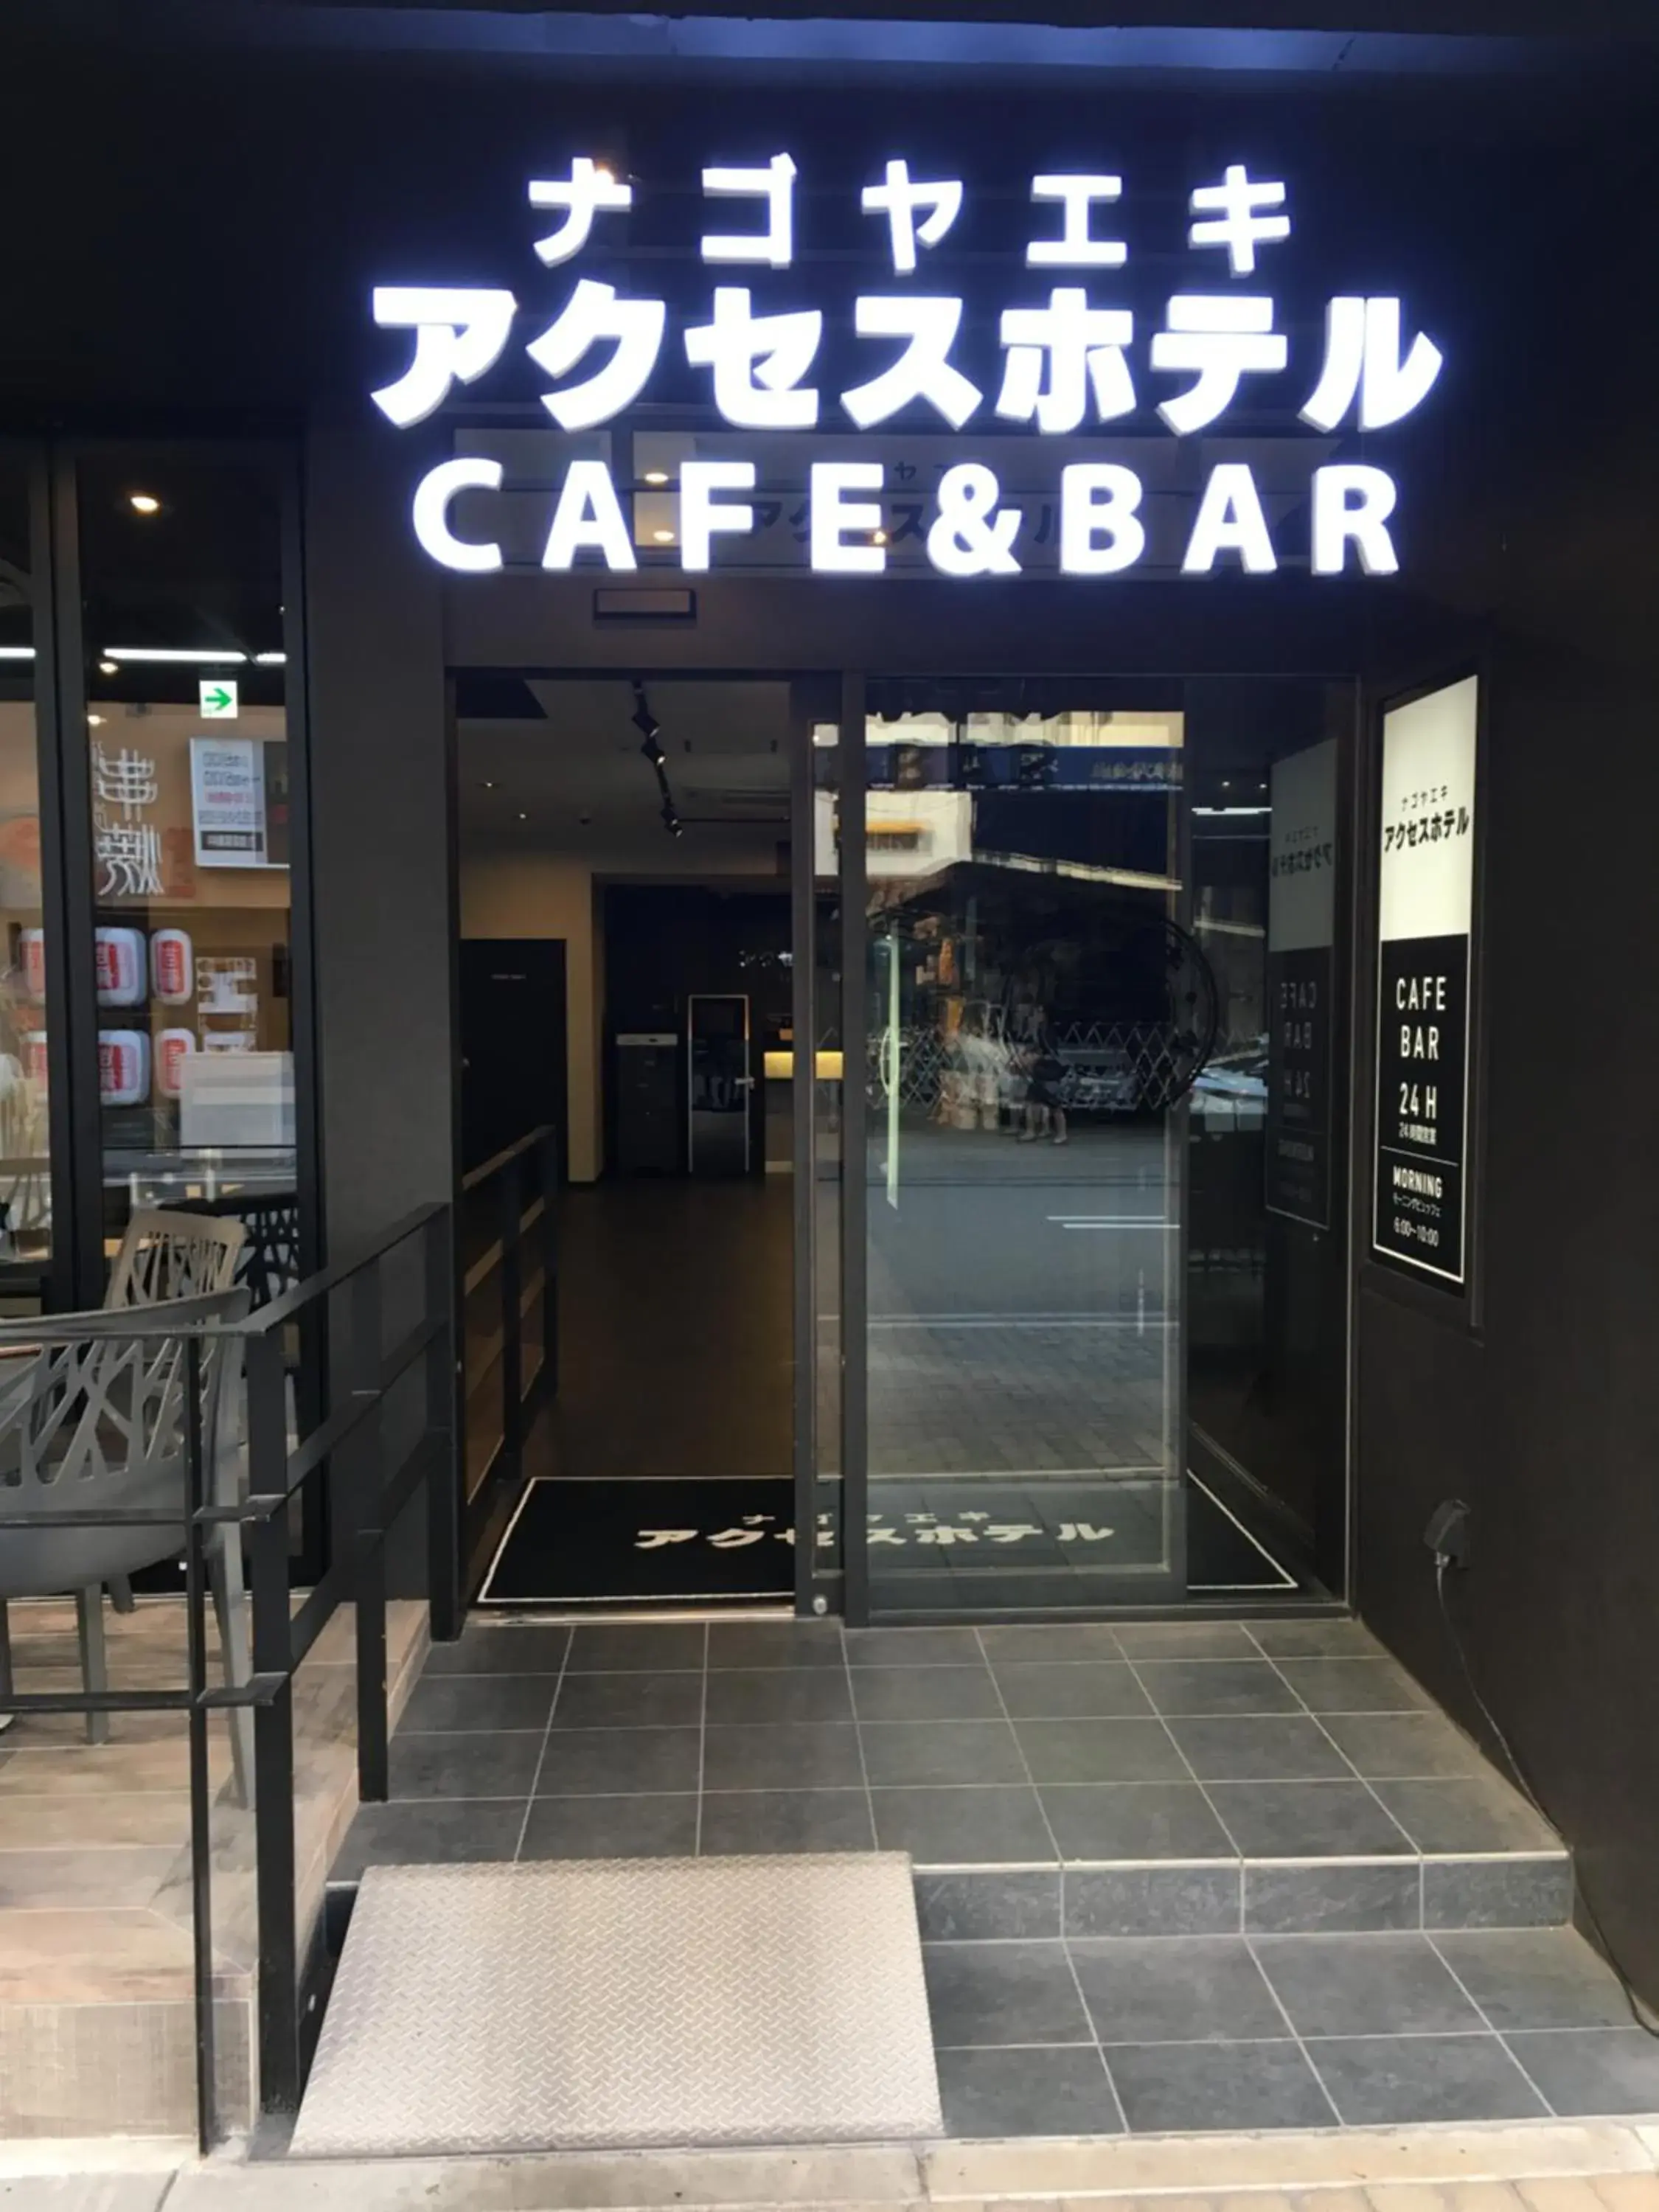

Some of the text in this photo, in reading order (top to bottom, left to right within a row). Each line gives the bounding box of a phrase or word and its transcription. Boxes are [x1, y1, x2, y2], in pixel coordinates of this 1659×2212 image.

[527, 151, 1292, 275] ナゴヤエキ
[369, 278, 1444, 434] アクセスホテル
[1384, 806, 1470, 853] アクセスホテル
[1396, 976, 1447, 1012] CAFE
[1401, 1025, 1440, 1060] BAR
[1393, 1165, 1443, 1199] MORNING
